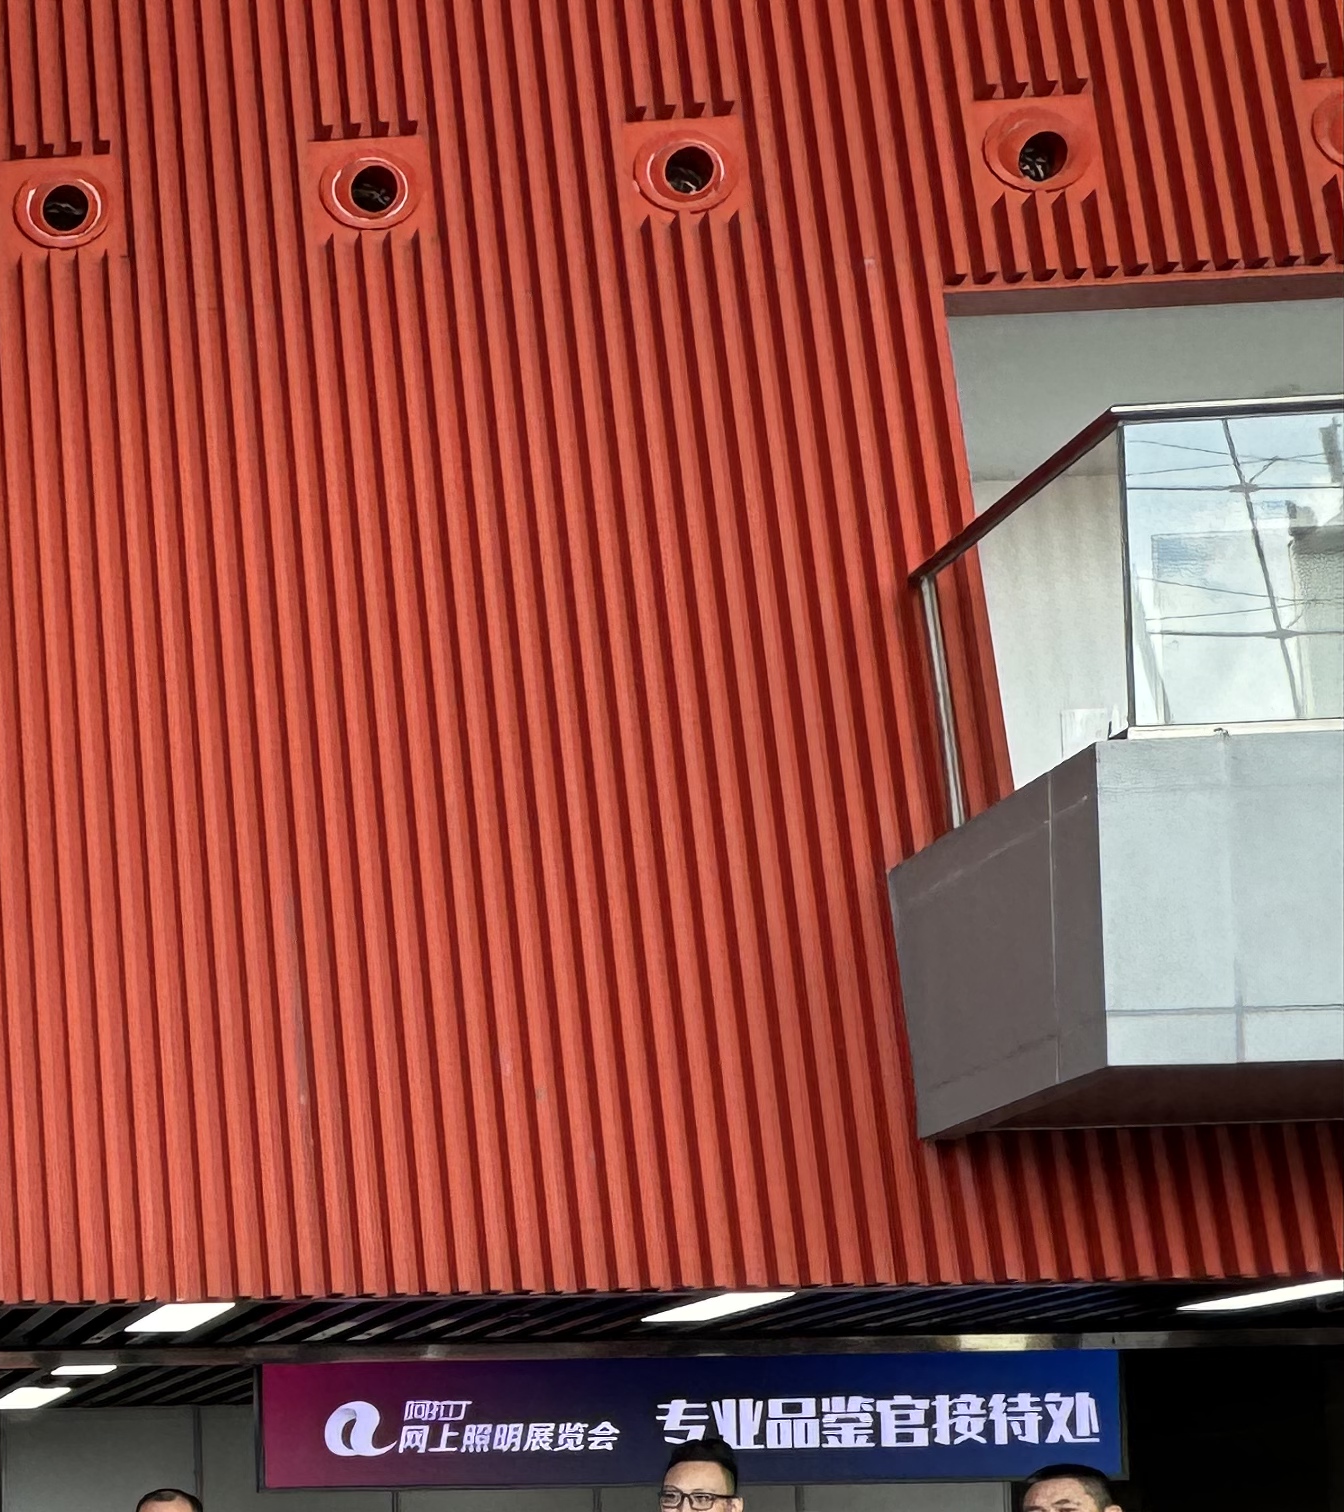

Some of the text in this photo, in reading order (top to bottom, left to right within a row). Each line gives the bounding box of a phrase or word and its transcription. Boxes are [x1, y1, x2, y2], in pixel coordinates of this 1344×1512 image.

[398, 1421, 621, 1454] 网上照明展览会
[656, 1391, 1102, 1450] 专业品鉴官接待处
